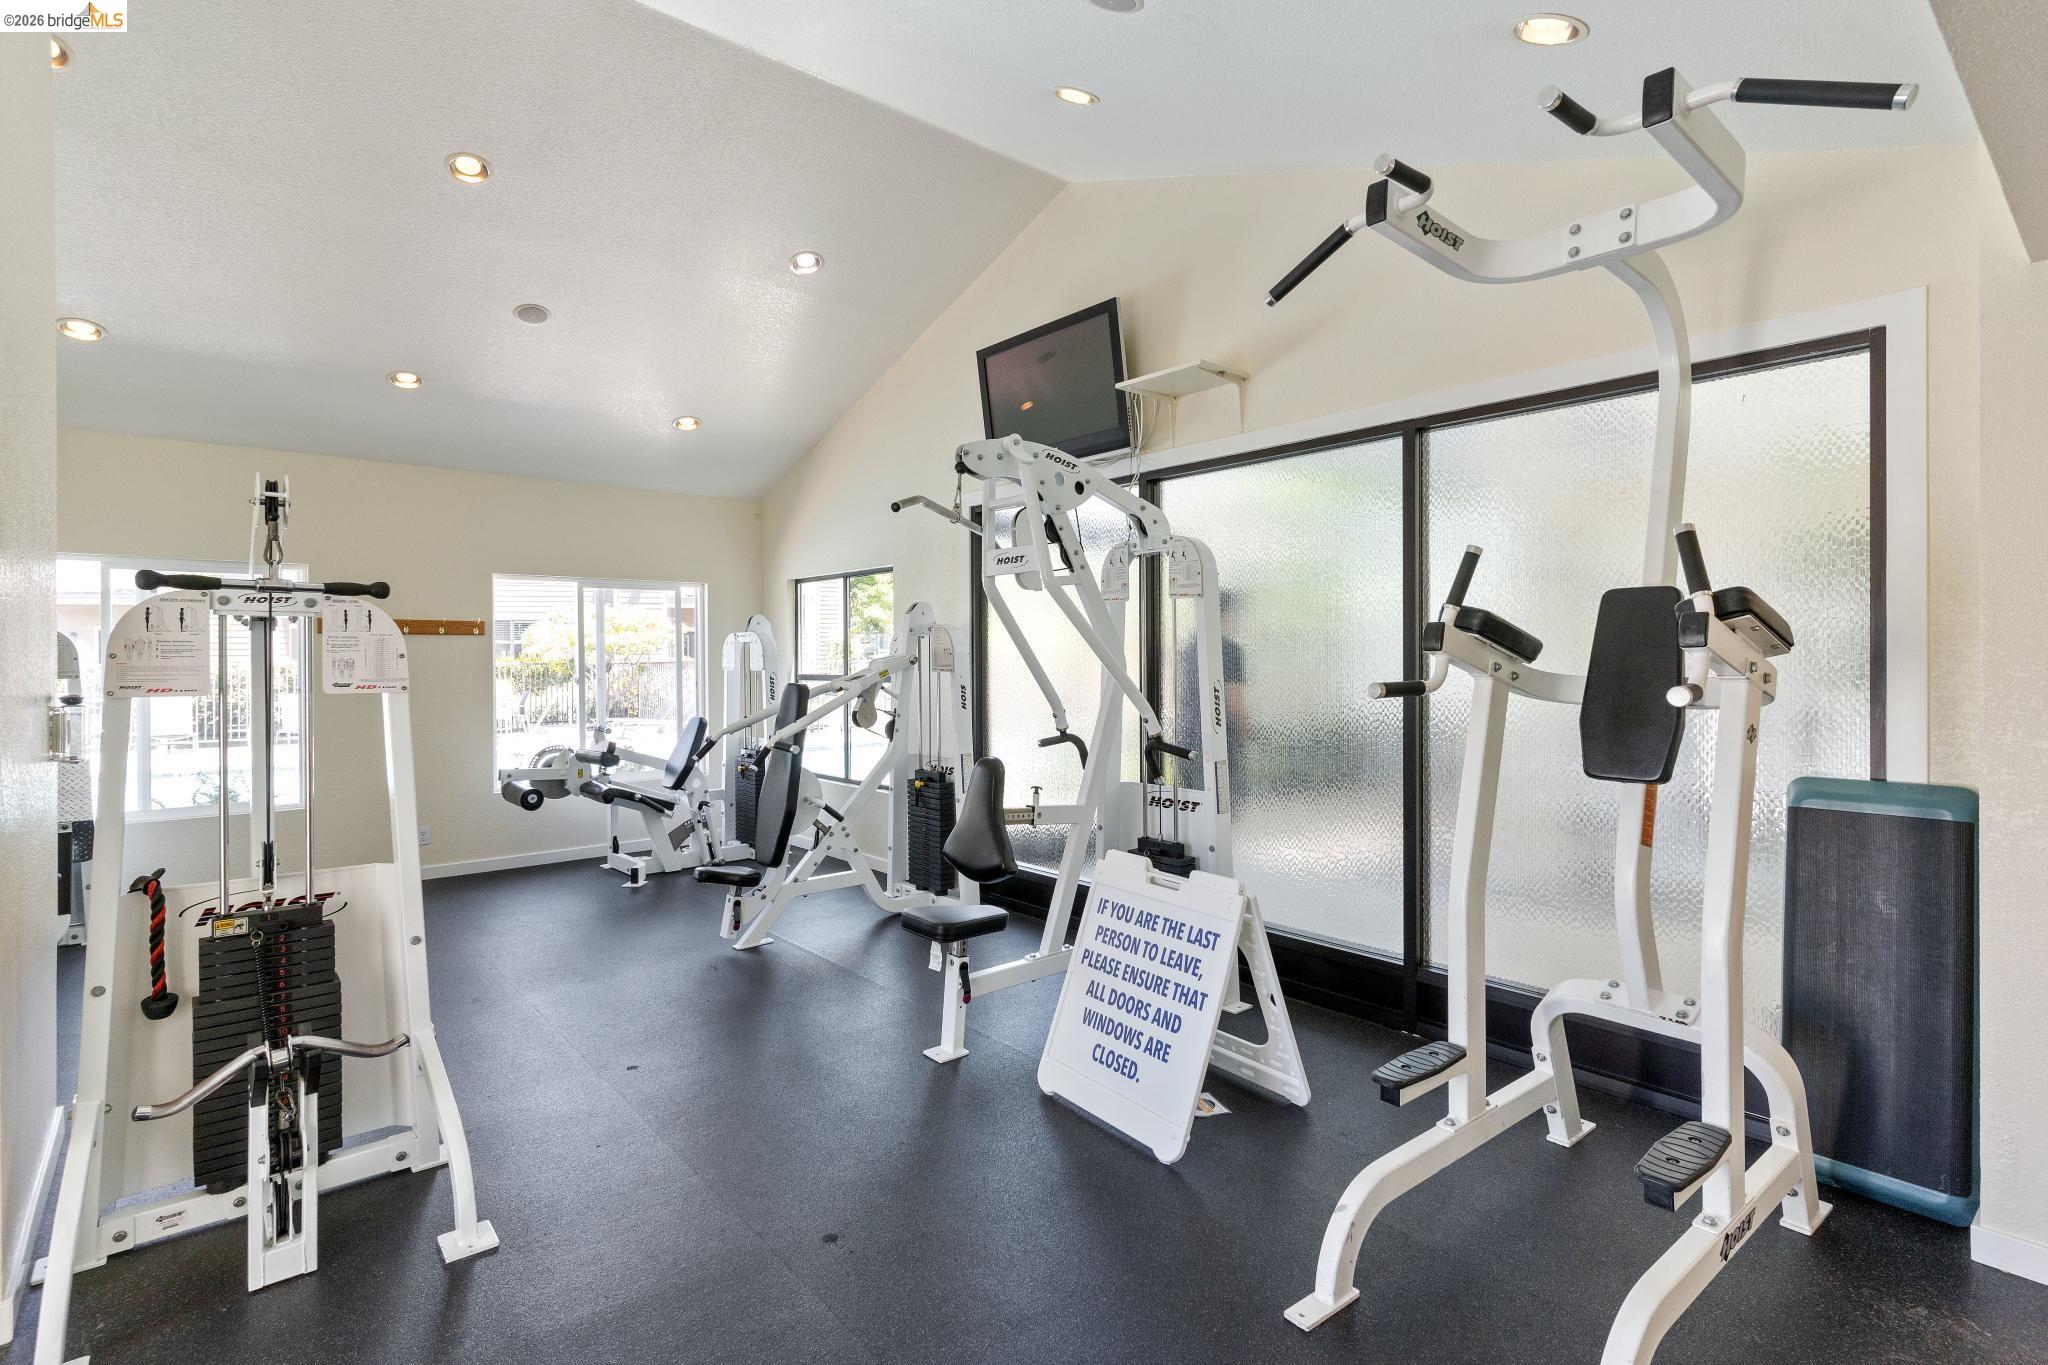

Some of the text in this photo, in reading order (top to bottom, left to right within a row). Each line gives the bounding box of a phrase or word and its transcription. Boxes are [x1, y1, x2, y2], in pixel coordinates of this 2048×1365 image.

[1416, 210, 1465, 252] HOIST
[1045, 452, 1077, 470] HOIST
[996, 554, 1025, 565] HOIST
[1213, 685, 1222, 728] HOIST
[1097, 898, 1220, 951] IF YOU ARE THE LAST
[1094, 925, 1203, 981] PERSON TO LEAVE,
[1081, 948, 1208, 1012] PLEASE ENSURE THAT
[1085, 979, 1183, 1035] ALL DOORS AND
[1082, 1006, 1172, 1064] WINDOWS ARE
[1091, 1043, 1140, 1083] CLOSED.
[1719, 1206, 1756, 1262] HOIST
